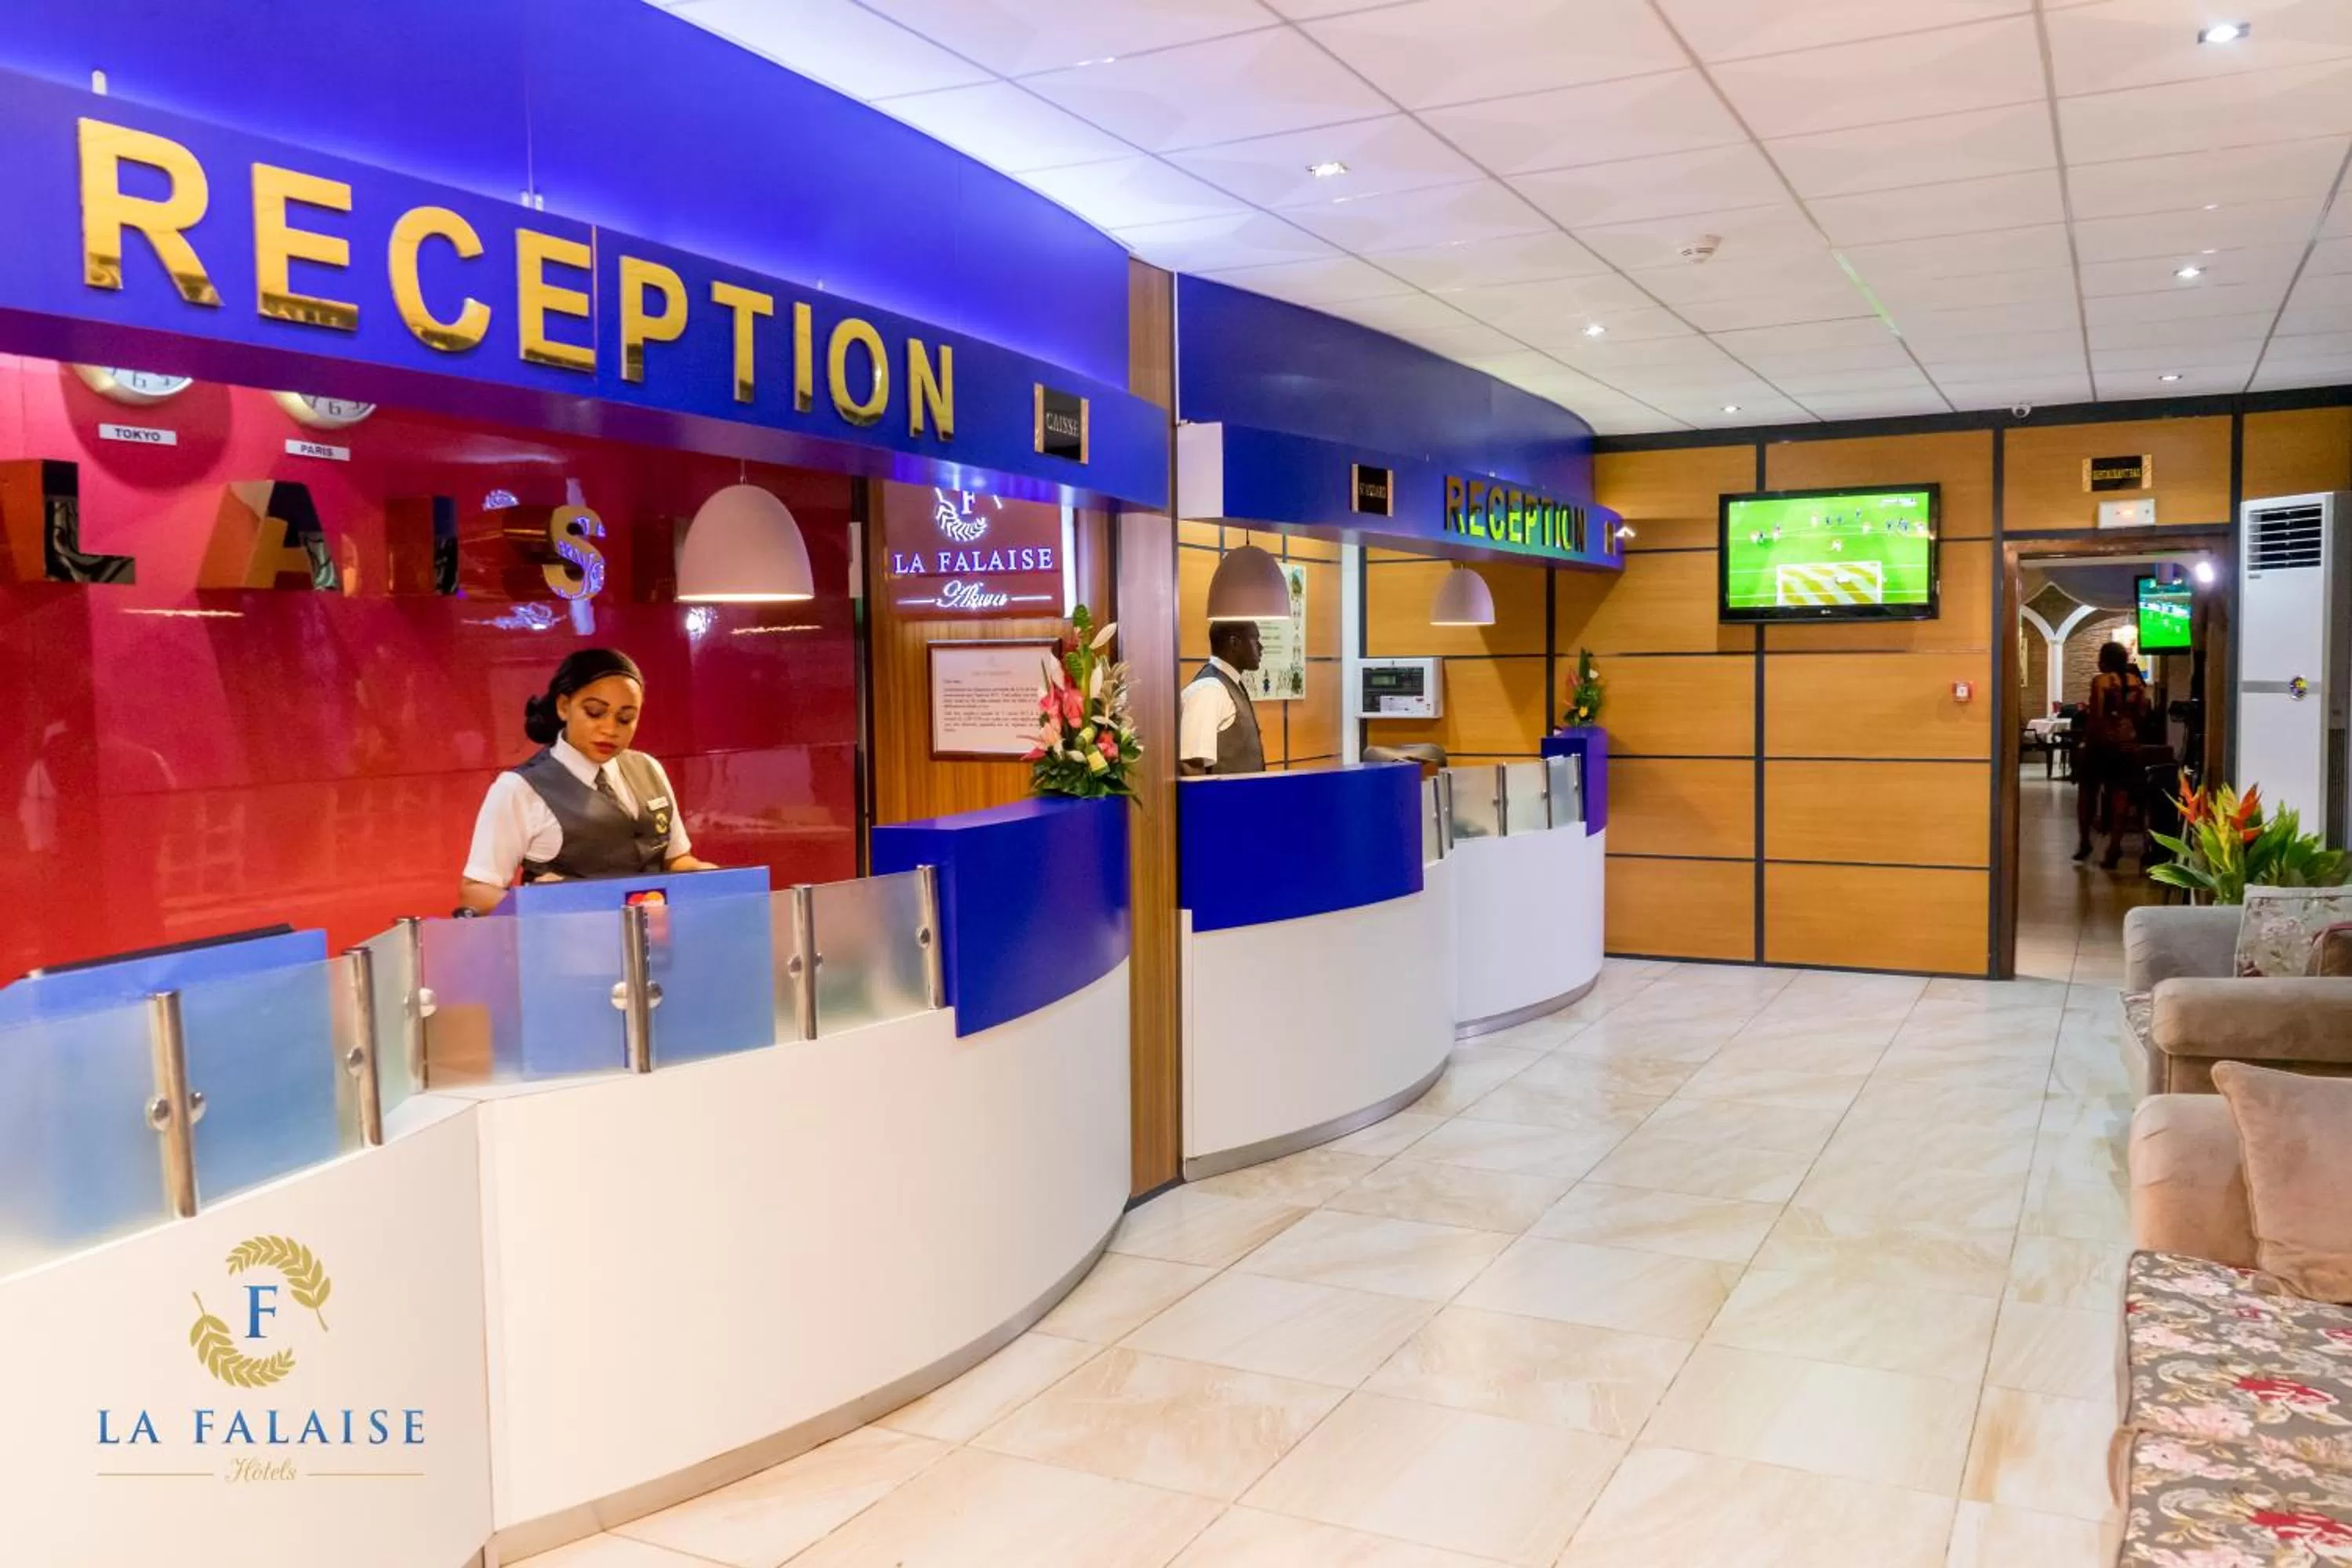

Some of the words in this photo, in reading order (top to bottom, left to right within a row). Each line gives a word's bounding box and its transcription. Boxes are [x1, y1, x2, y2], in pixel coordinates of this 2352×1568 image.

[78, 116, 955, 441] RECEPTION
[114, 427, 162, 442] TOKYO
[300, 444, 334, 457] PARIS
[0, 459, 694, 601] LAIS
[1444, 475, 1587, 553] RECEPTION
[895, 554, 926, 574] LA
[938, 548, 1054, 572] FALAISE
